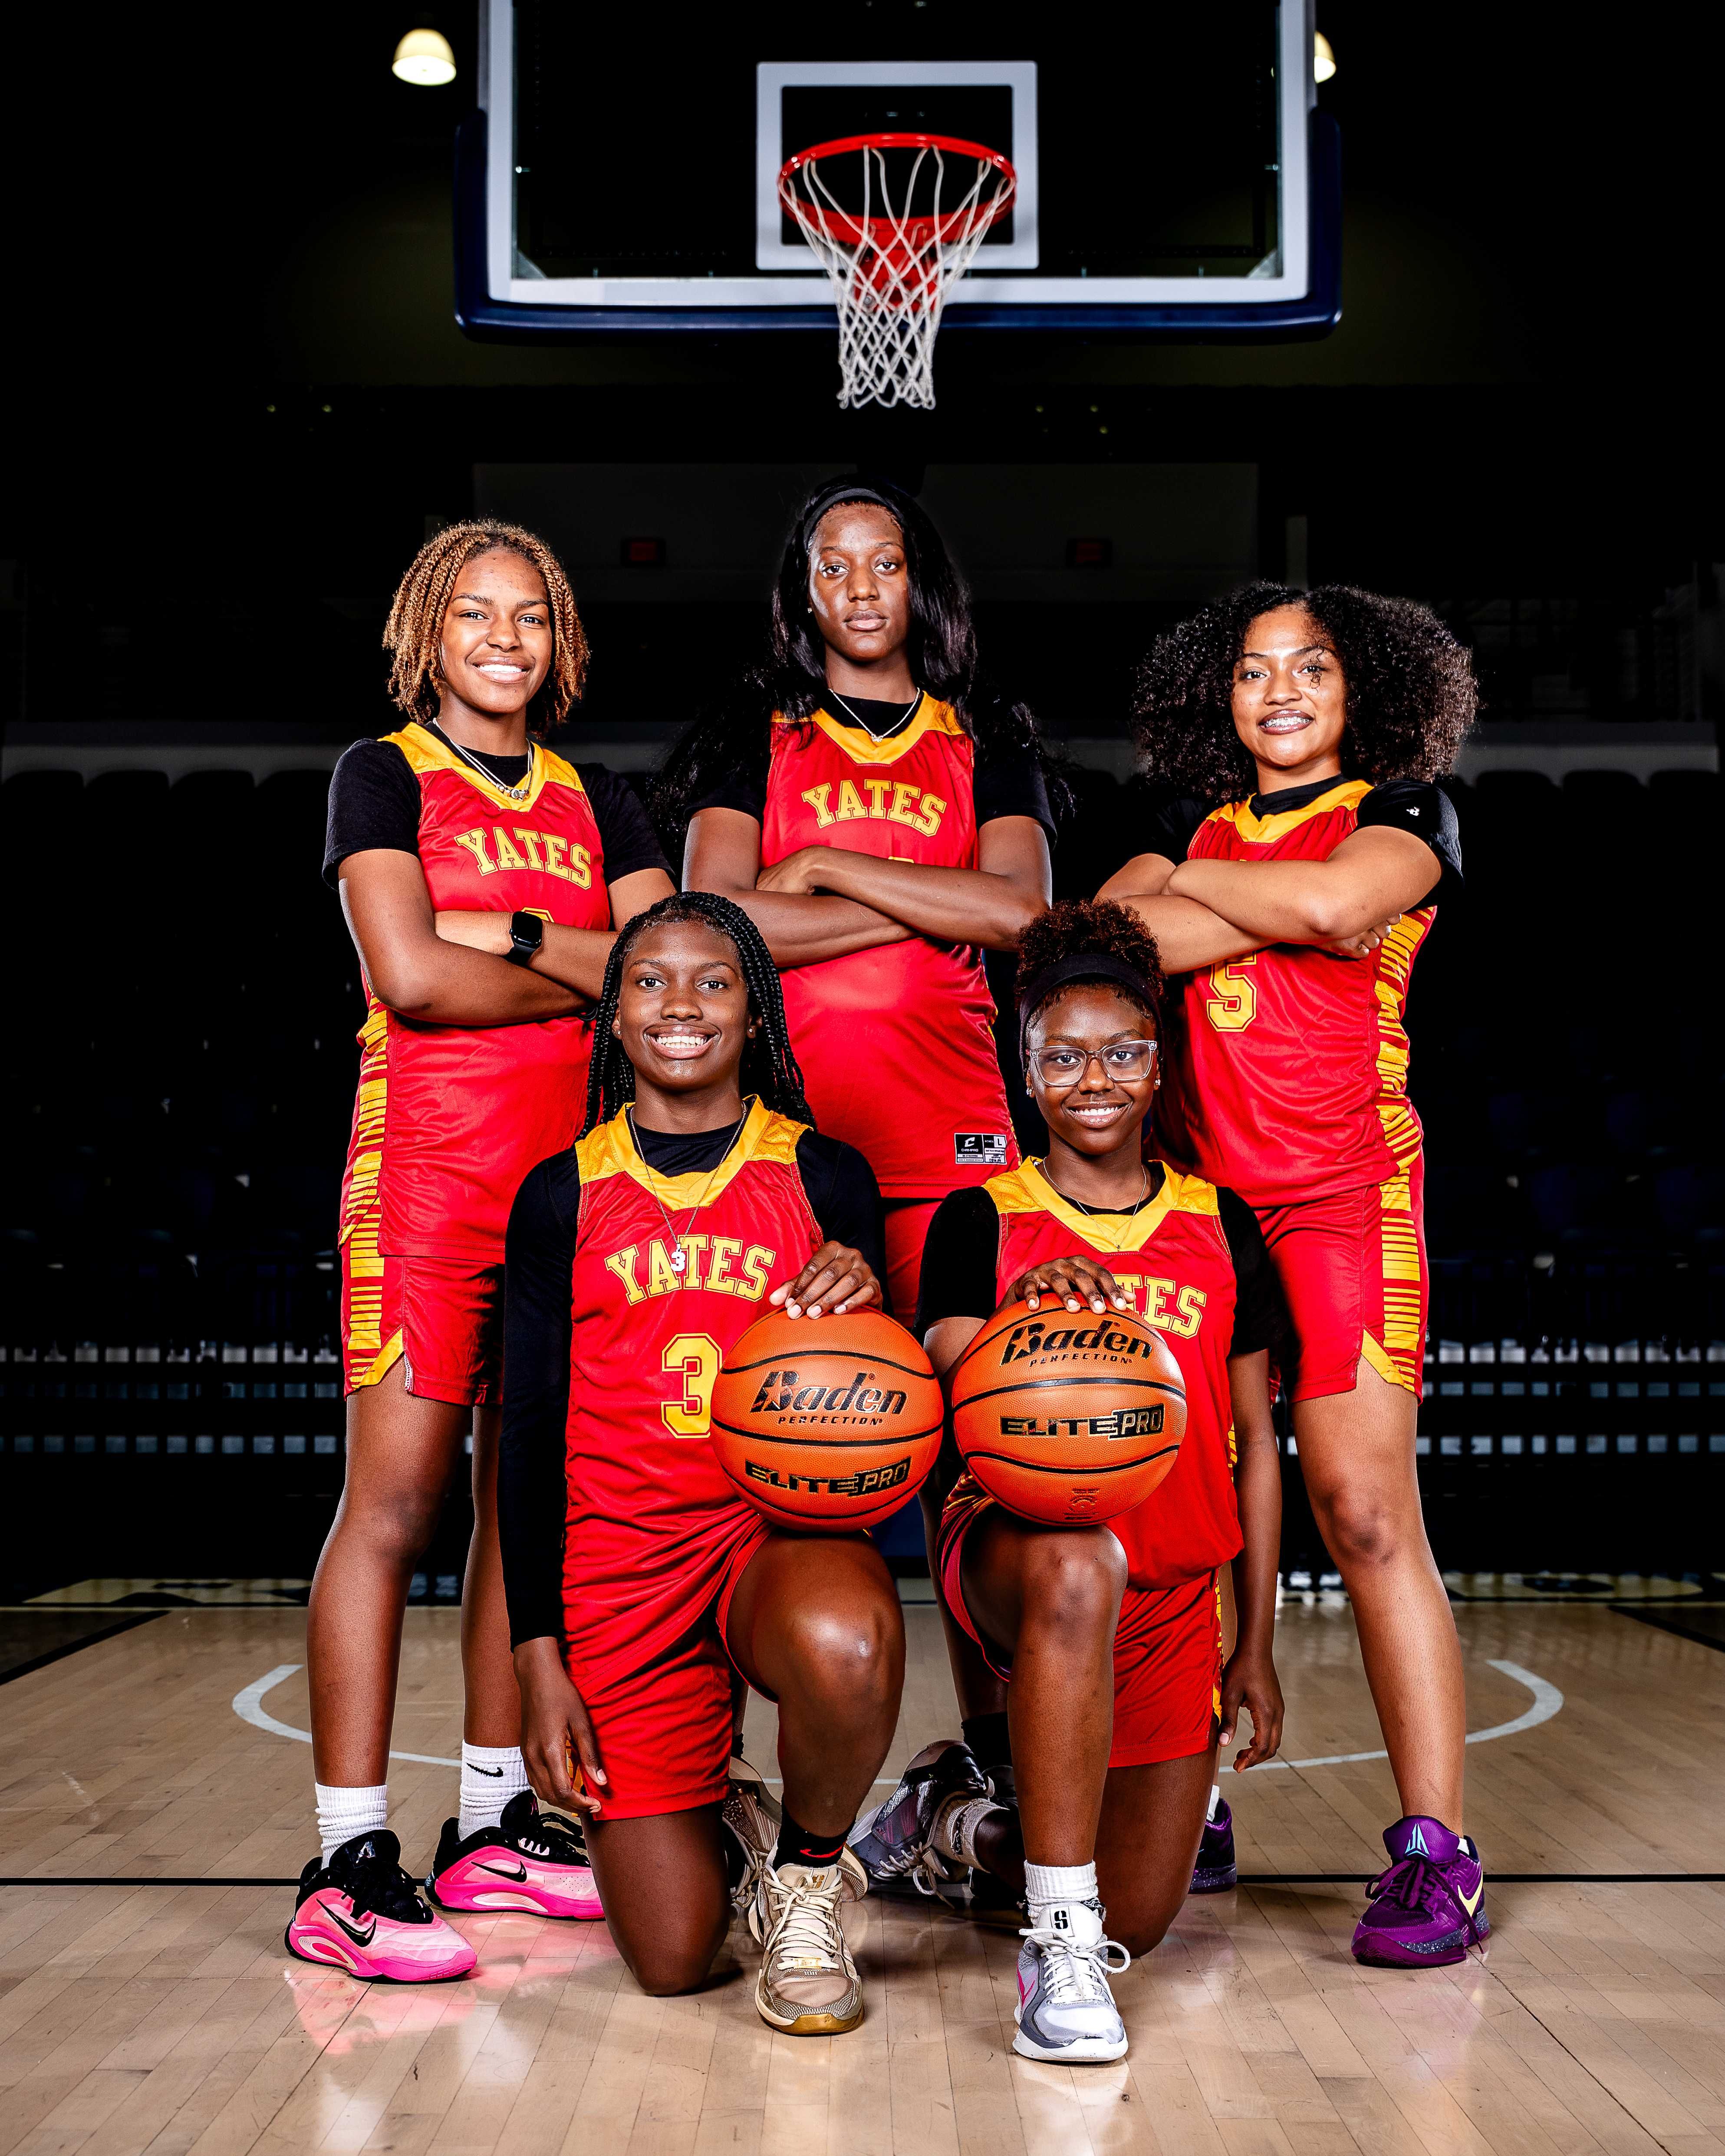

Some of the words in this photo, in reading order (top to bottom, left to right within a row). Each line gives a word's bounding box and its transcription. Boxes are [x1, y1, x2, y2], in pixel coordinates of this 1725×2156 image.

[801, 779, 947, 837] YATES
[454, 827, 592, 890] YATES
[1206, 951, 1257, 1032] 5
[604, 1234, 777, 1306] YATES
[671, 1250, 686, 1272] 3
[1112, 1273, 1207, 1340] TES
[1000, 1319, 1153, 1367] Baden
[661, 1333, 722, 1439] 3
[750, 1371, 908, 1415] Baden
[1054, 1910, 1068, 1929] S
